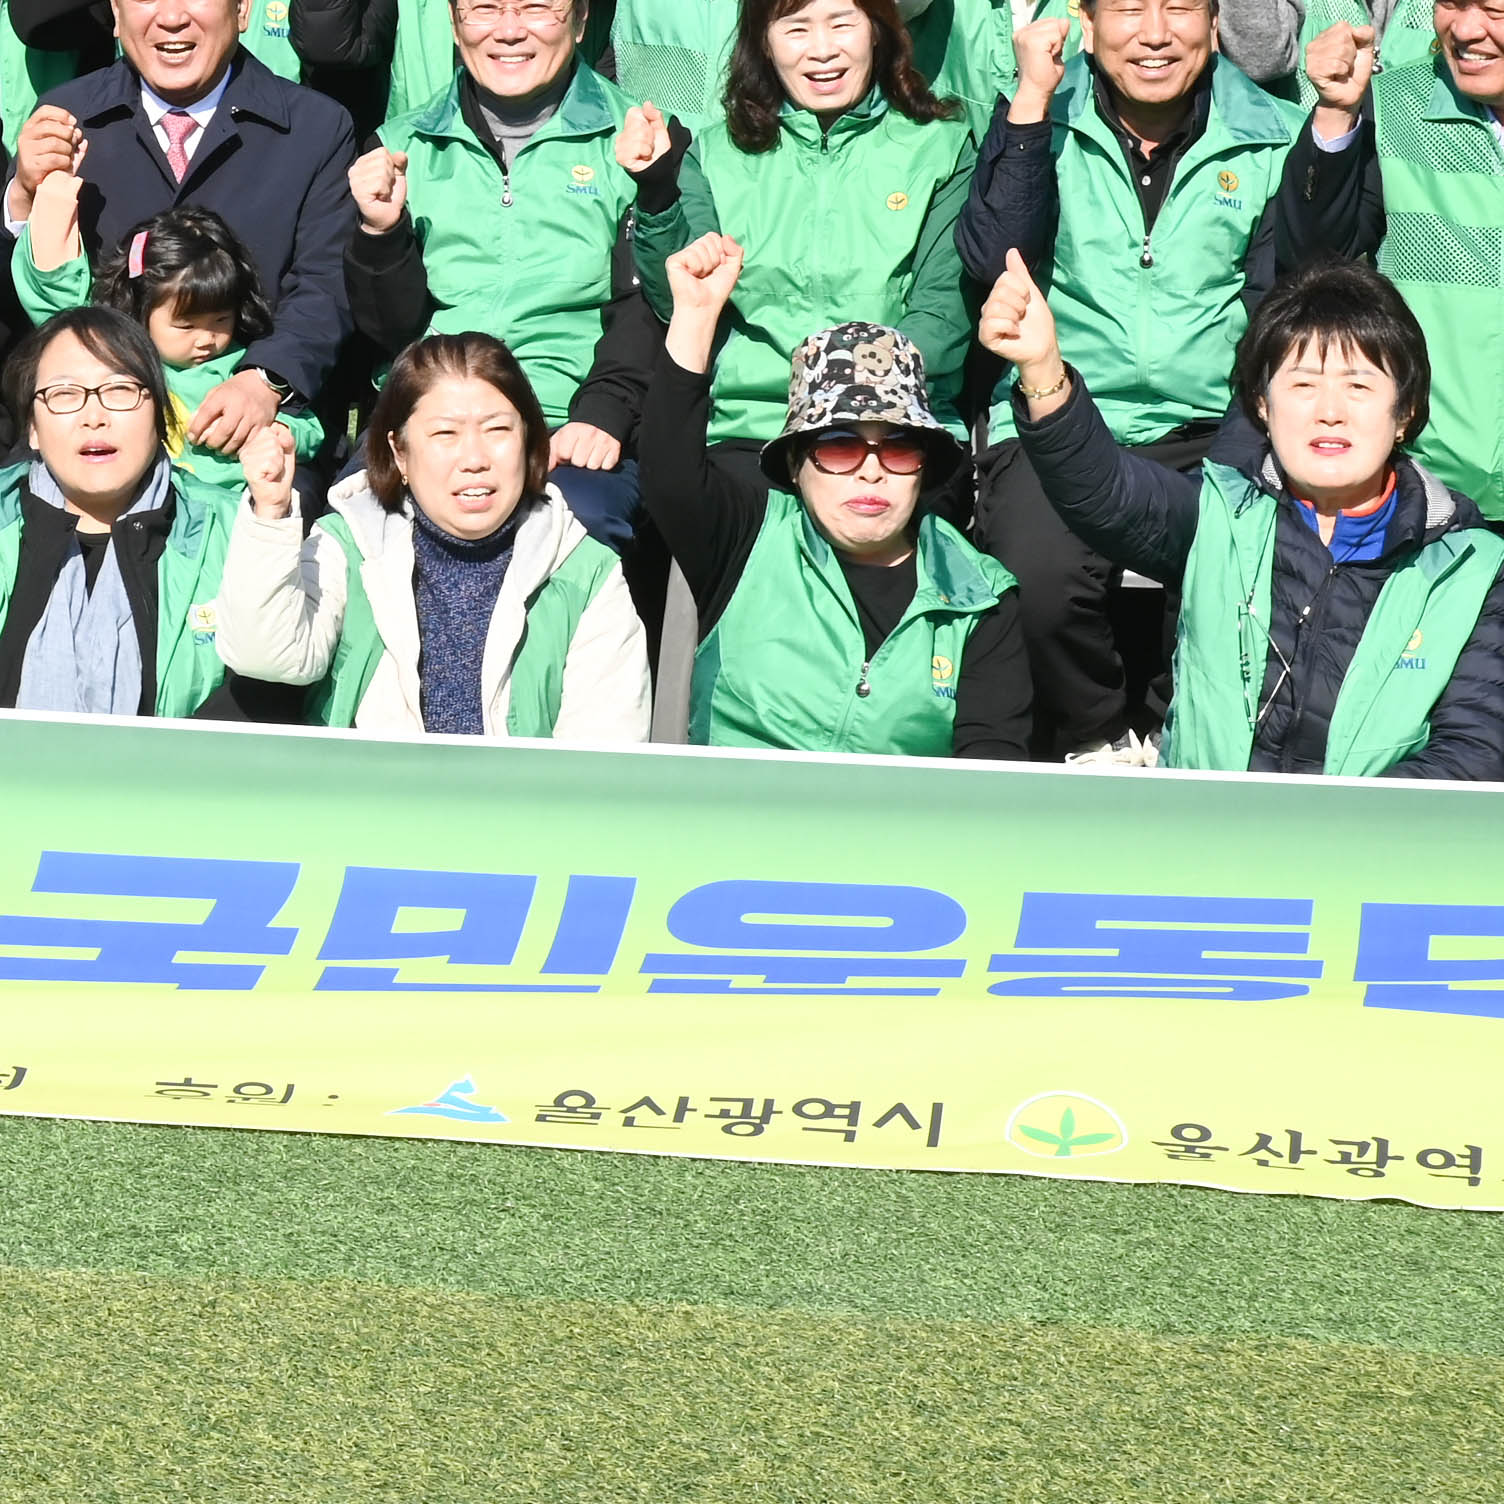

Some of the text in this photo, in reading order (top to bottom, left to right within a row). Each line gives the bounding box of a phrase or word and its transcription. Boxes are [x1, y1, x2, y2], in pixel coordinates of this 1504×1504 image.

[566, 184, 599, 197] SMU
[1214, 195, 1242, 211] SMU
[194, 632, 216, 647] SM
[533, 1088, 946, 1149] 울산광역시
[1151, 1122, 1504, 1187] 울산광역
